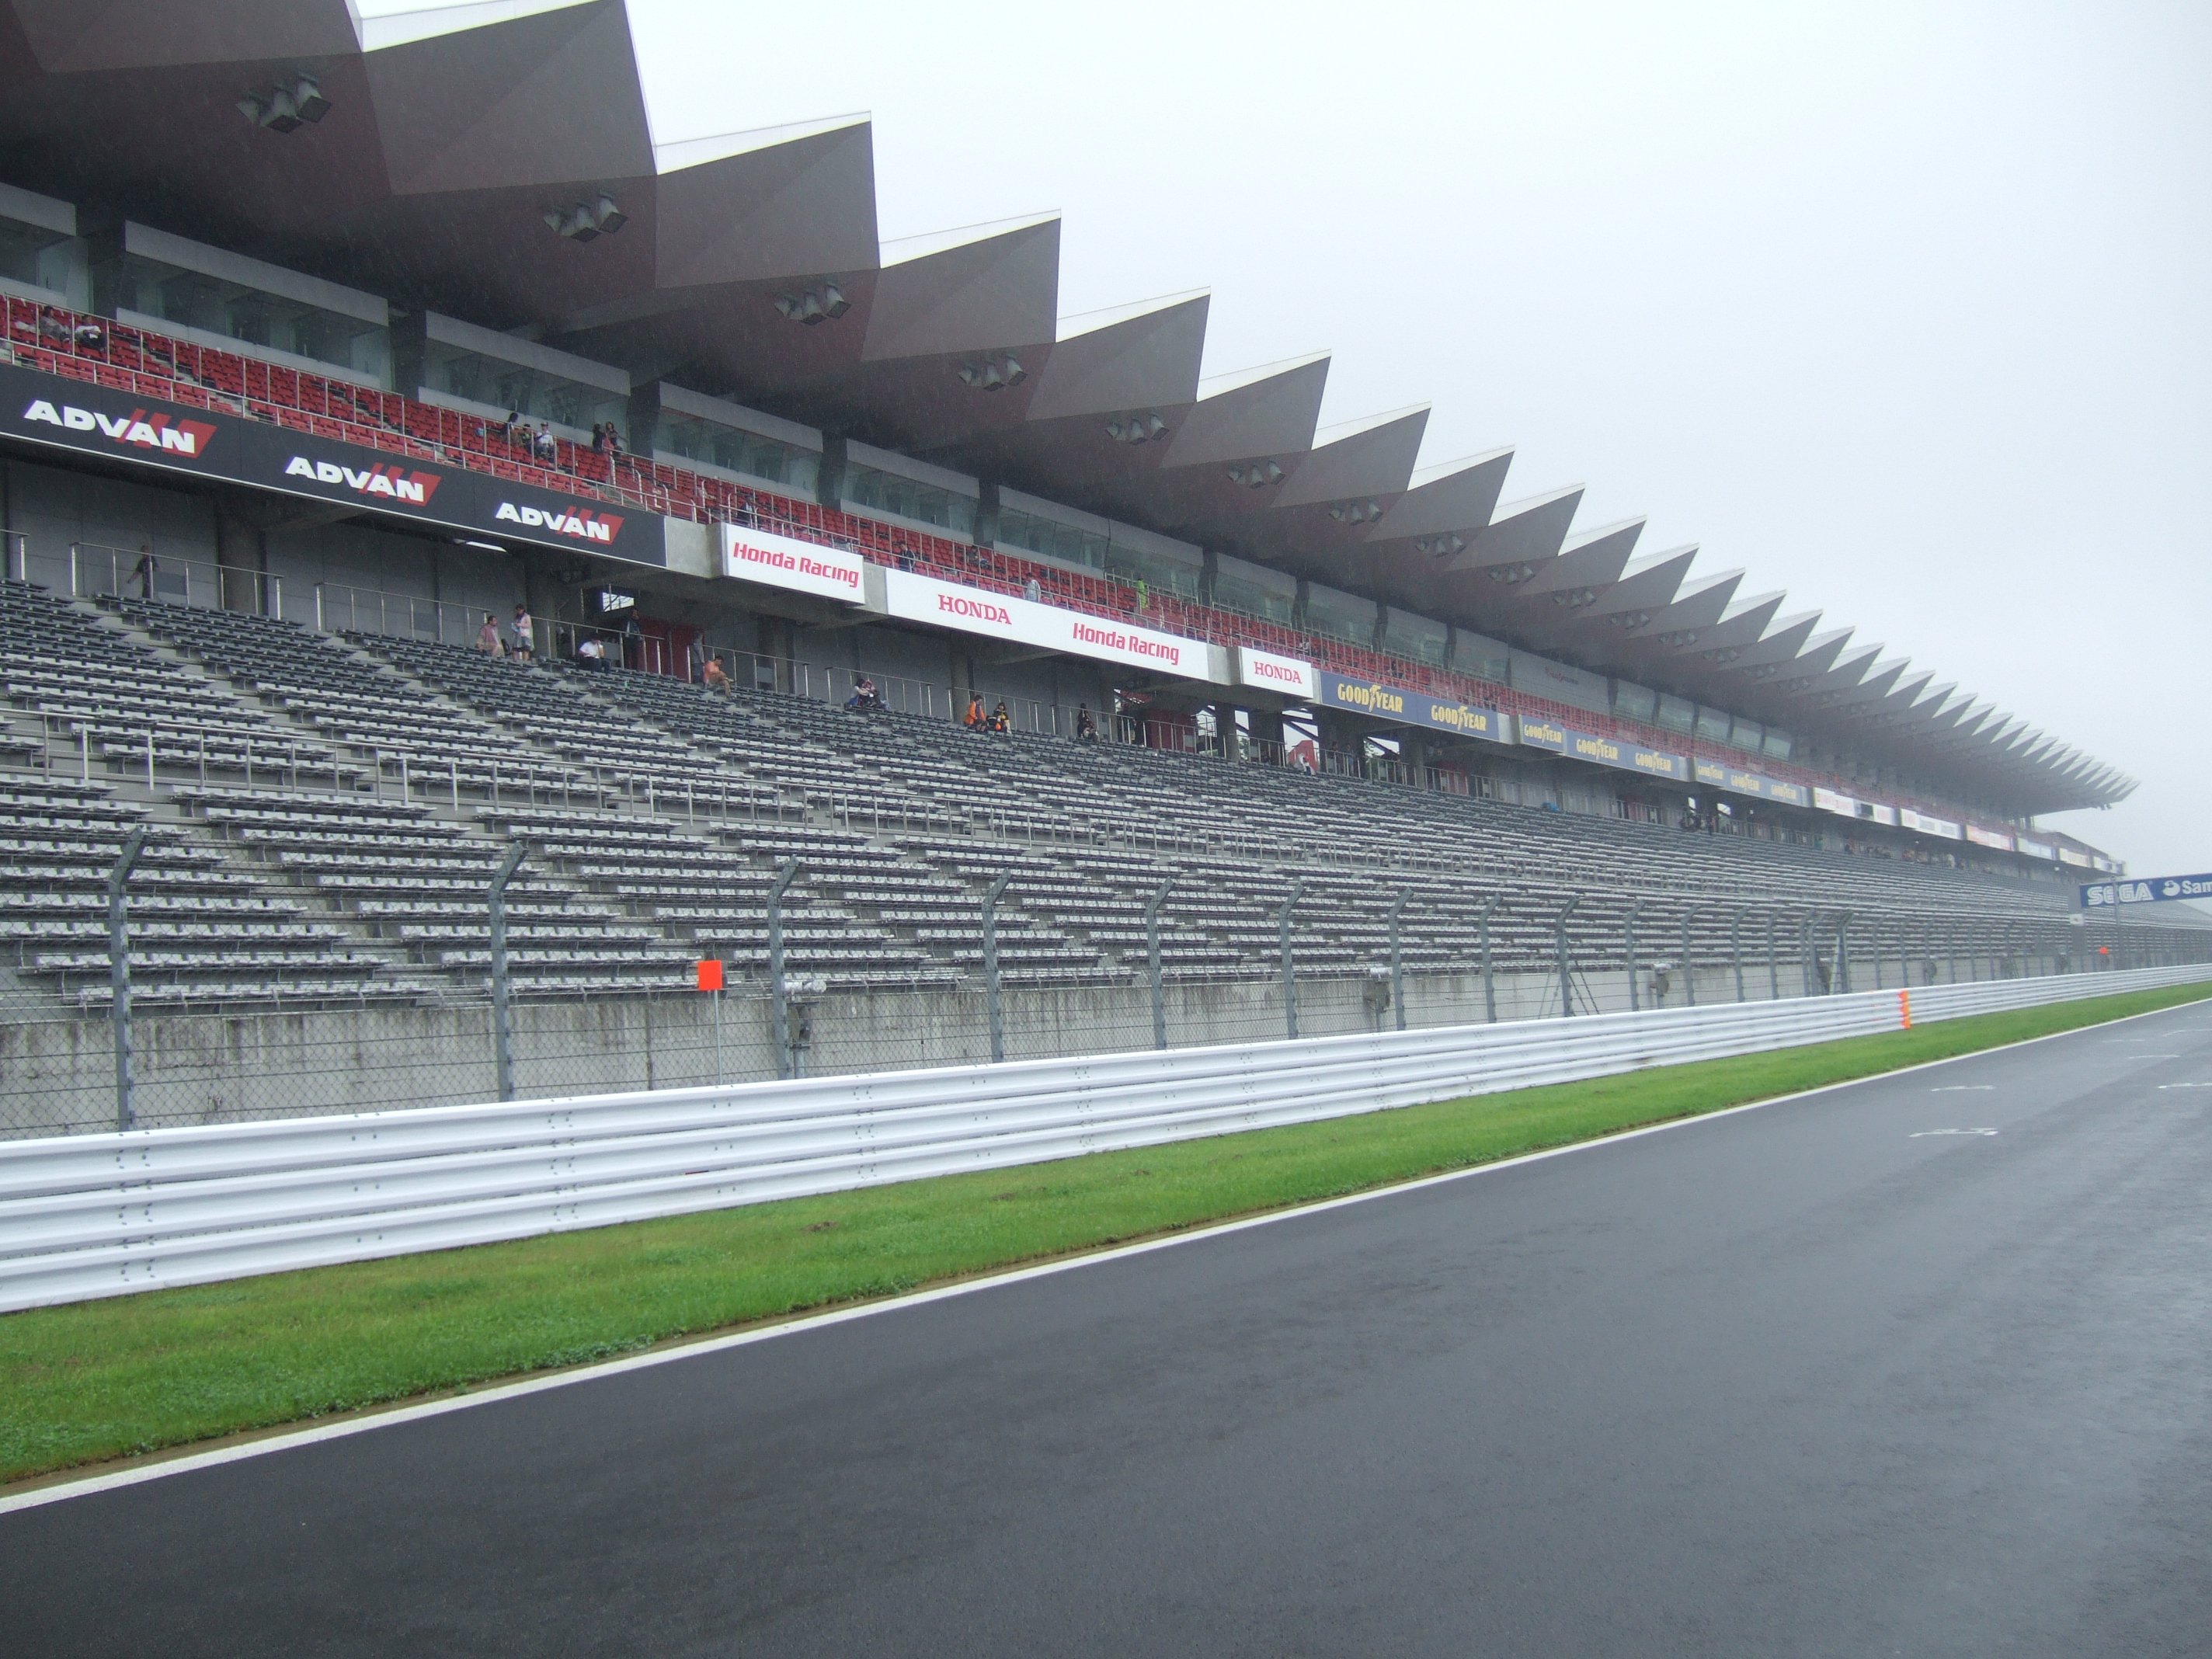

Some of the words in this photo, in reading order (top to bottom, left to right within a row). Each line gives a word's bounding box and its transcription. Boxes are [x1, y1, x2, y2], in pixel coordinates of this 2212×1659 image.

[23, 400, 195, 454] ADVAN
[286, 456, 424, 502] ADVAN
[496, 502, 610, 541] ADVAN
[733, 542, 796, 570] Honda
[798, 557, 859, 588] Racing
[938, 594, 1011, 625] HONDA
[1073, 622, 1126, 649] Honda
[1129, 636, 1179, 666] Racing
[1254, 661, 1302, 683] HONDA
[2087, 882, 2155, 906] SEGA
